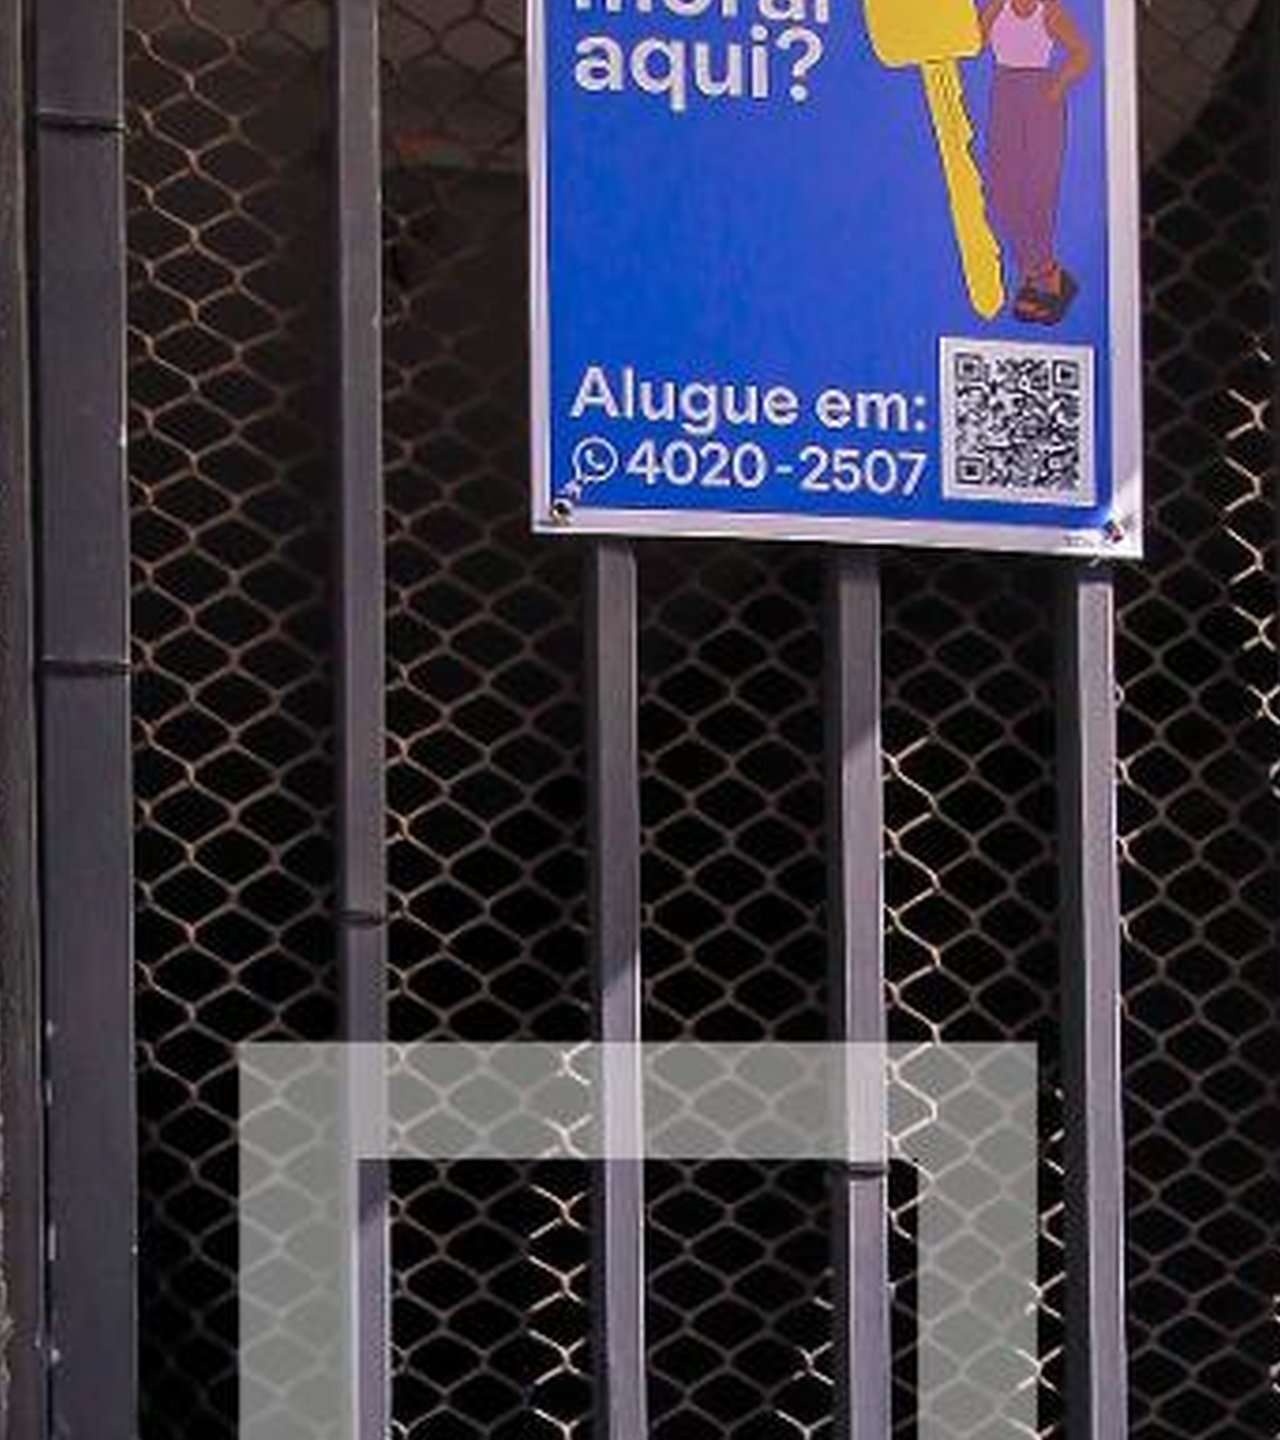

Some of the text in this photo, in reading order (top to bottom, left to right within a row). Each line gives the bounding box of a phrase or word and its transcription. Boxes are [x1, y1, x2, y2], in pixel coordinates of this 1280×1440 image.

[574, 26, 823, 112] aqui?
[570, 366, 927, 434] Alugue em:
[626, 440, 927, 496] 4020-2507
